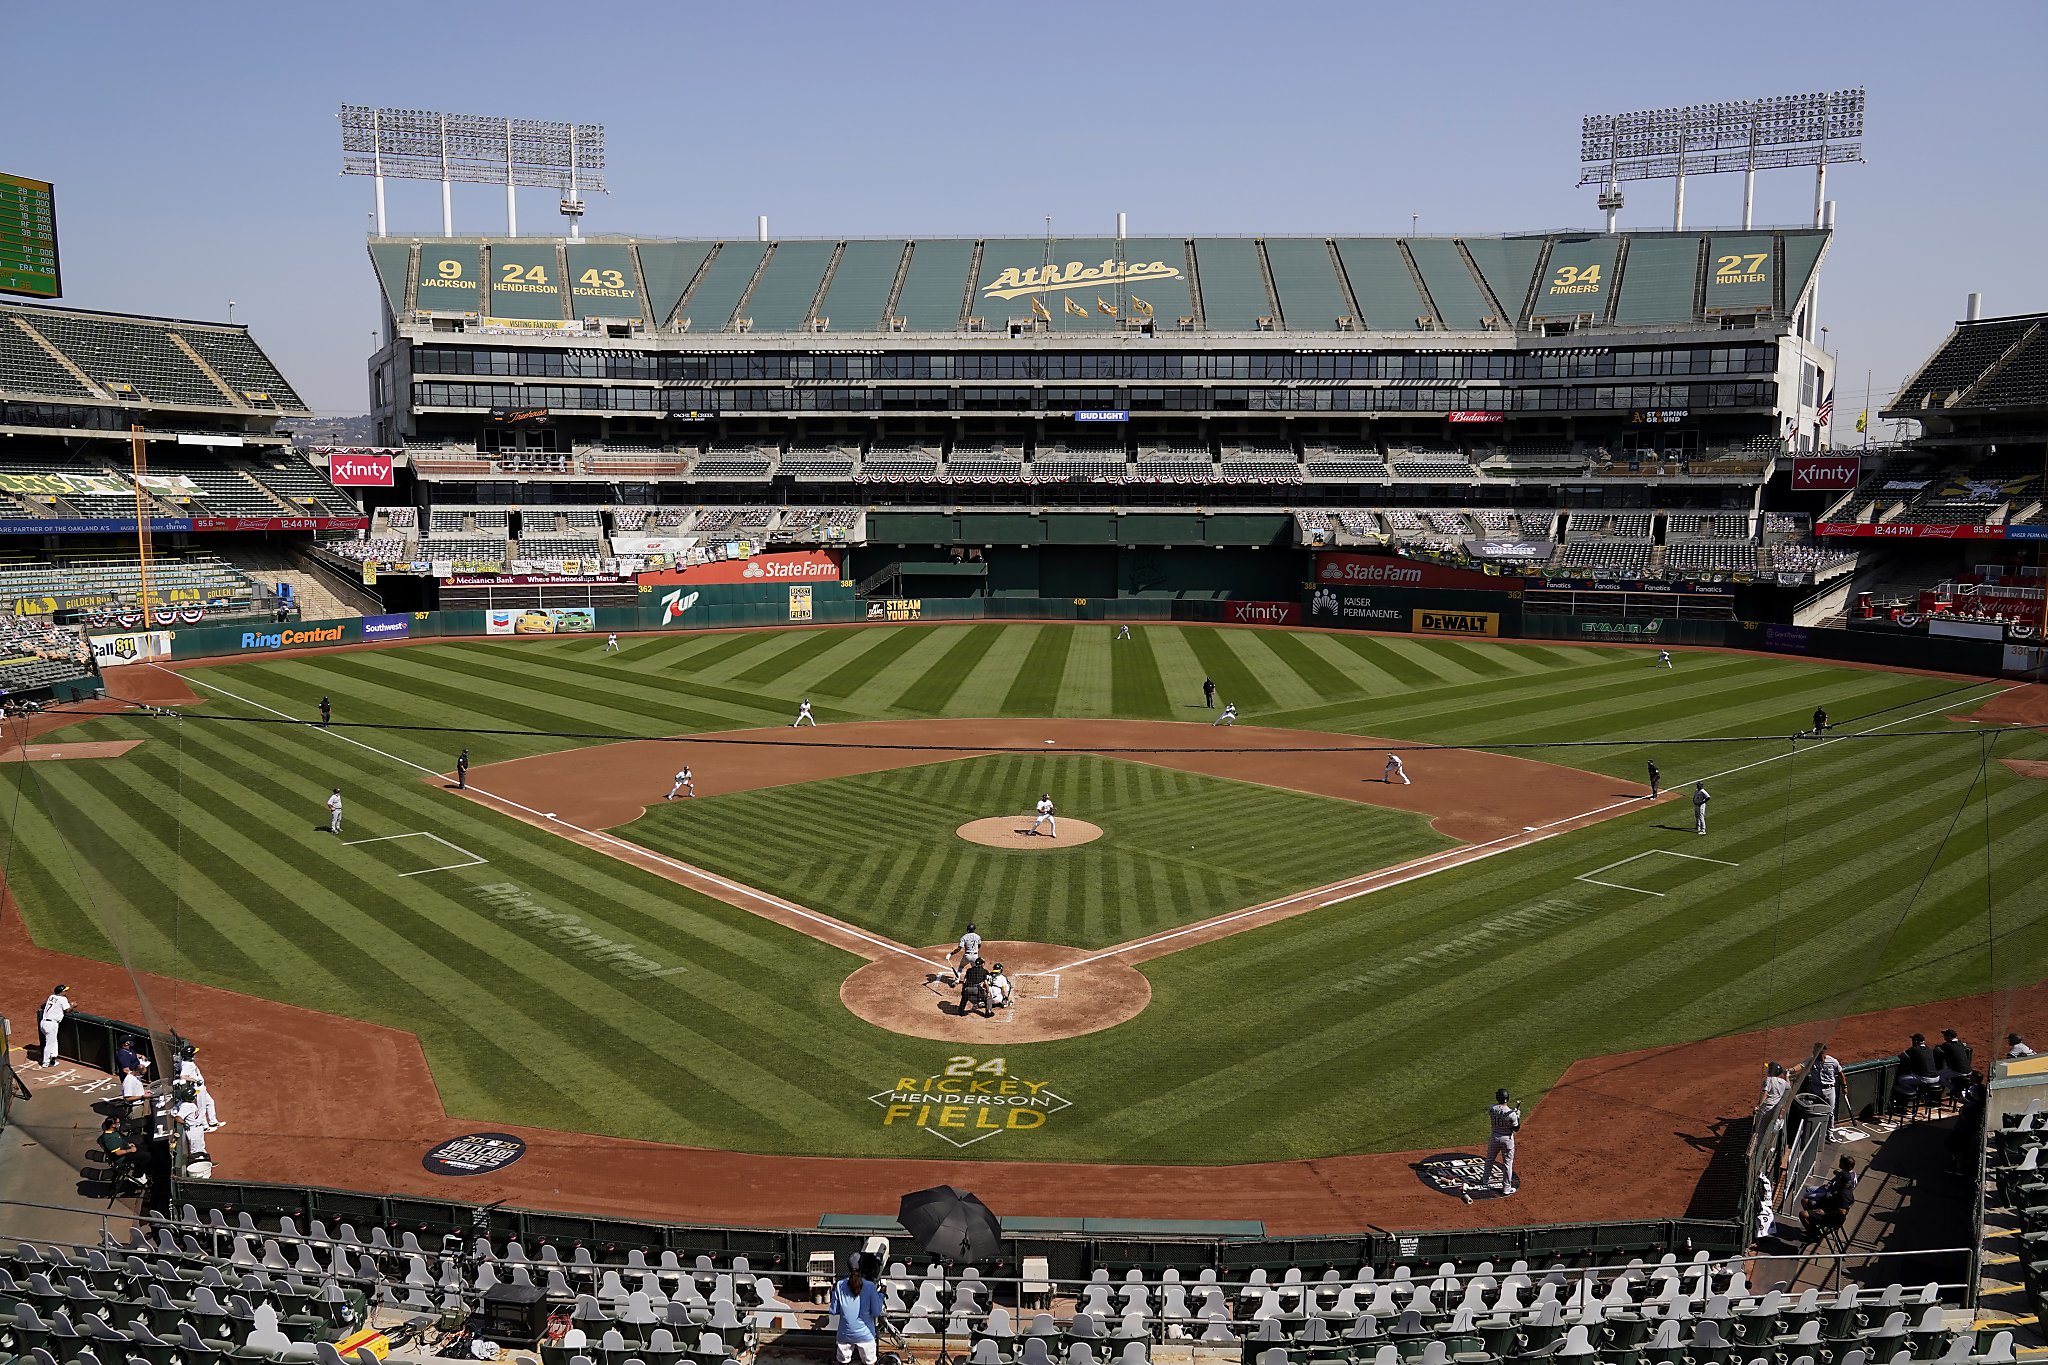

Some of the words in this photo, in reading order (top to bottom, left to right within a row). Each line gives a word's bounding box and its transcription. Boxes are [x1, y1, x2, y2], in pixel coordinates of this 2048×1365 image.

[20, 264, 34, 272] ERA
[40, 266, 56, 275] 4.50
[438, 260, 462, 279] 9
[1716, 254, 1768, 275] 27
[502, 264, 548, 285] 24
[579, 268, 625, 289] 43
[982, 258, 1180, 300] Athletics
[1553, 264, 1601, 286] 34
[1716, 274, 1766, 285] HUNTER
[422, 278, 476, 289] JACKSON
[493, 282, 558, 294] HENDERSON
[573, 286, 636, 298] ECKERSLEY
[1550, 284, 1599, 295] FINGERS
[510, 320, 532, 328] VISITING
[532, 321, 544, 329] FAN
[544, 321, 558, 330] ZONE
[508, 409, 548, 423] Treehouse
[1452, 411, 1502, 422] Budweiser
[335, 461, 390, 480] xfinity
[1798, 464, 1856, 484] xfinity
[166, 522, 187, 530] thrive
[280, 520, 302, 528] 12:44
[304, 520, 317, 528] PM
[1874, 526, 1898, 534] 12:44
[1899, 526, 1914, 535] PM
[1973, 526, 1990, 534] 95.6
[766, 561, 801, 578] State
[802, 560, 836, 576] Farm
[1344, 564, 1380, 580] State
[1382, 564, 1422, 582] Farm
[550, 576, 594, 584] Relationships
[1546, 582, 1572, 590] Fanatics
[1594, 582, 1620, 590] Fanatics
[1644, 584, 1671, 592] Fanatics
[66, 598, 94, 609] GOLDEN
[886, 600, 920, 610] STREAM
[1344, 598, 1371, 606] KAISER
[414, 612, 430, 620] 367
[887, 610, 909, 620] YOUR
[1235, 603, 1289, 623] xfinity
[1343, 608, 1400, 619] PERMANENTE
[365, 622, 402, 632] Southwest
[1744, 622, 1759, 630] 367
[242, 626, 342, 649] RingCentral
[93, 643, 114, 657] Call
[115, 638, 135, 652] 811
[2012, 646, 2029, 656] 330
[944, 1056, 1007, 1078] 24
[896, 1077, 1050, 1095] RICKEY
[889, 1093, 1050, 1107] HENDERSON
[883, 1104, 1047, 1130] FIELD
[444, 1141, 482, 1156] WILD
[479, 1146, 518, 1160] CARD
[431, 1150, 504, 1168] SERIES
